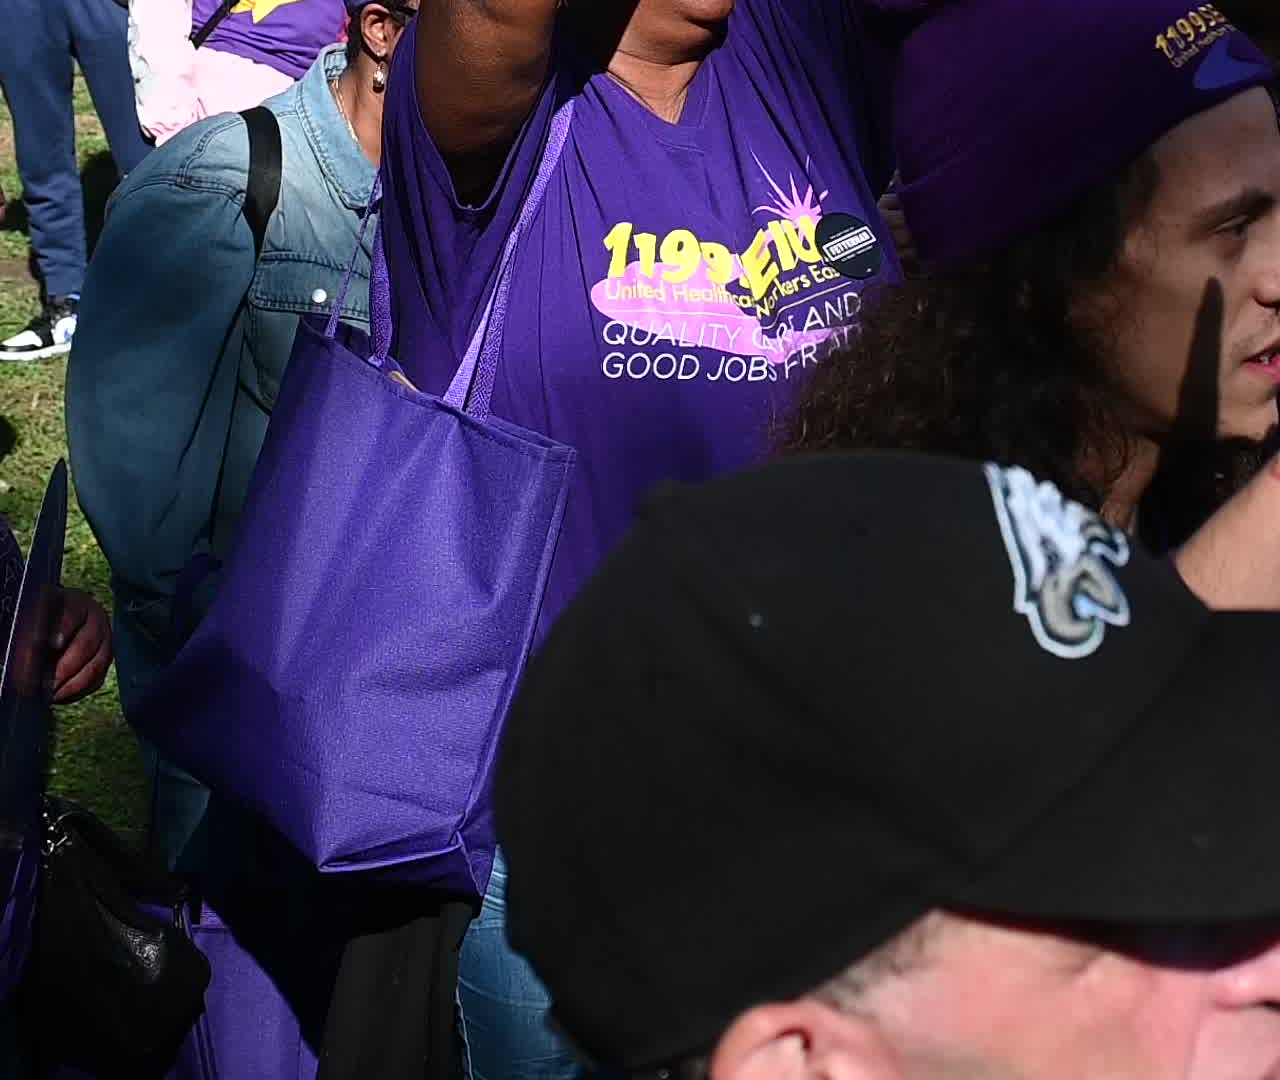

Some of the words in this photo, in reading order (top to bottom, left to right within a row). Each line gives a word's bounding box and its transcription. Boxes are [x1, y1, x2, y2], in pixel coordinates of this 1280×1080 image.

[828, 230, 872, 257] FETTERMAN
[607, 278, 666, 301] United
[602, 320, 743, 349] QUALITY
[802, 291, 862, 334] AND
[602, 352, 700, 381] GOOD
[706, 355, 778, 382] JOBS
